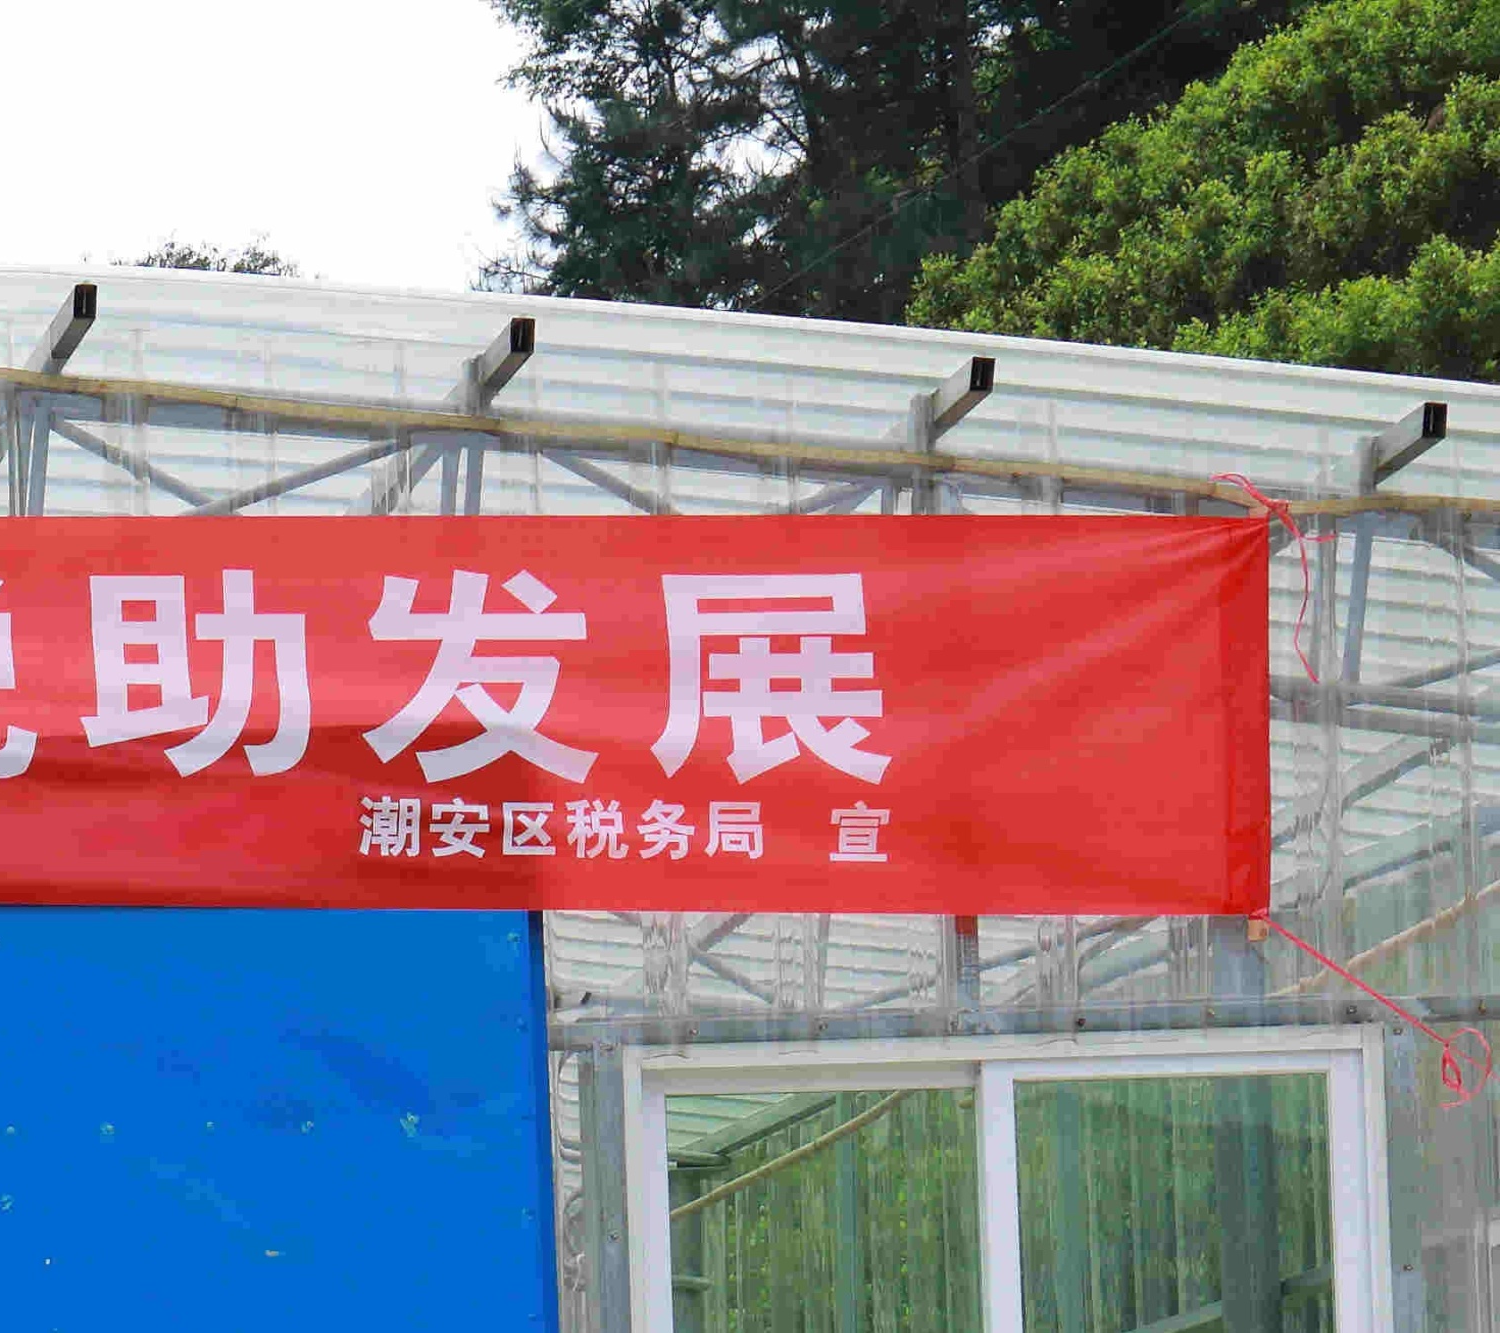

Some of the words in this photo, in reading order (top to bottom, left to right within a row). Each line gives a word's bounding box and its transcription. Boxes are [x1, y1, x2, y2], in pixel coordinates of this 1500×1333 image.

[358, 796, 765, 860] 潮安区税务局
[829, 801, 891, 863] 宣
